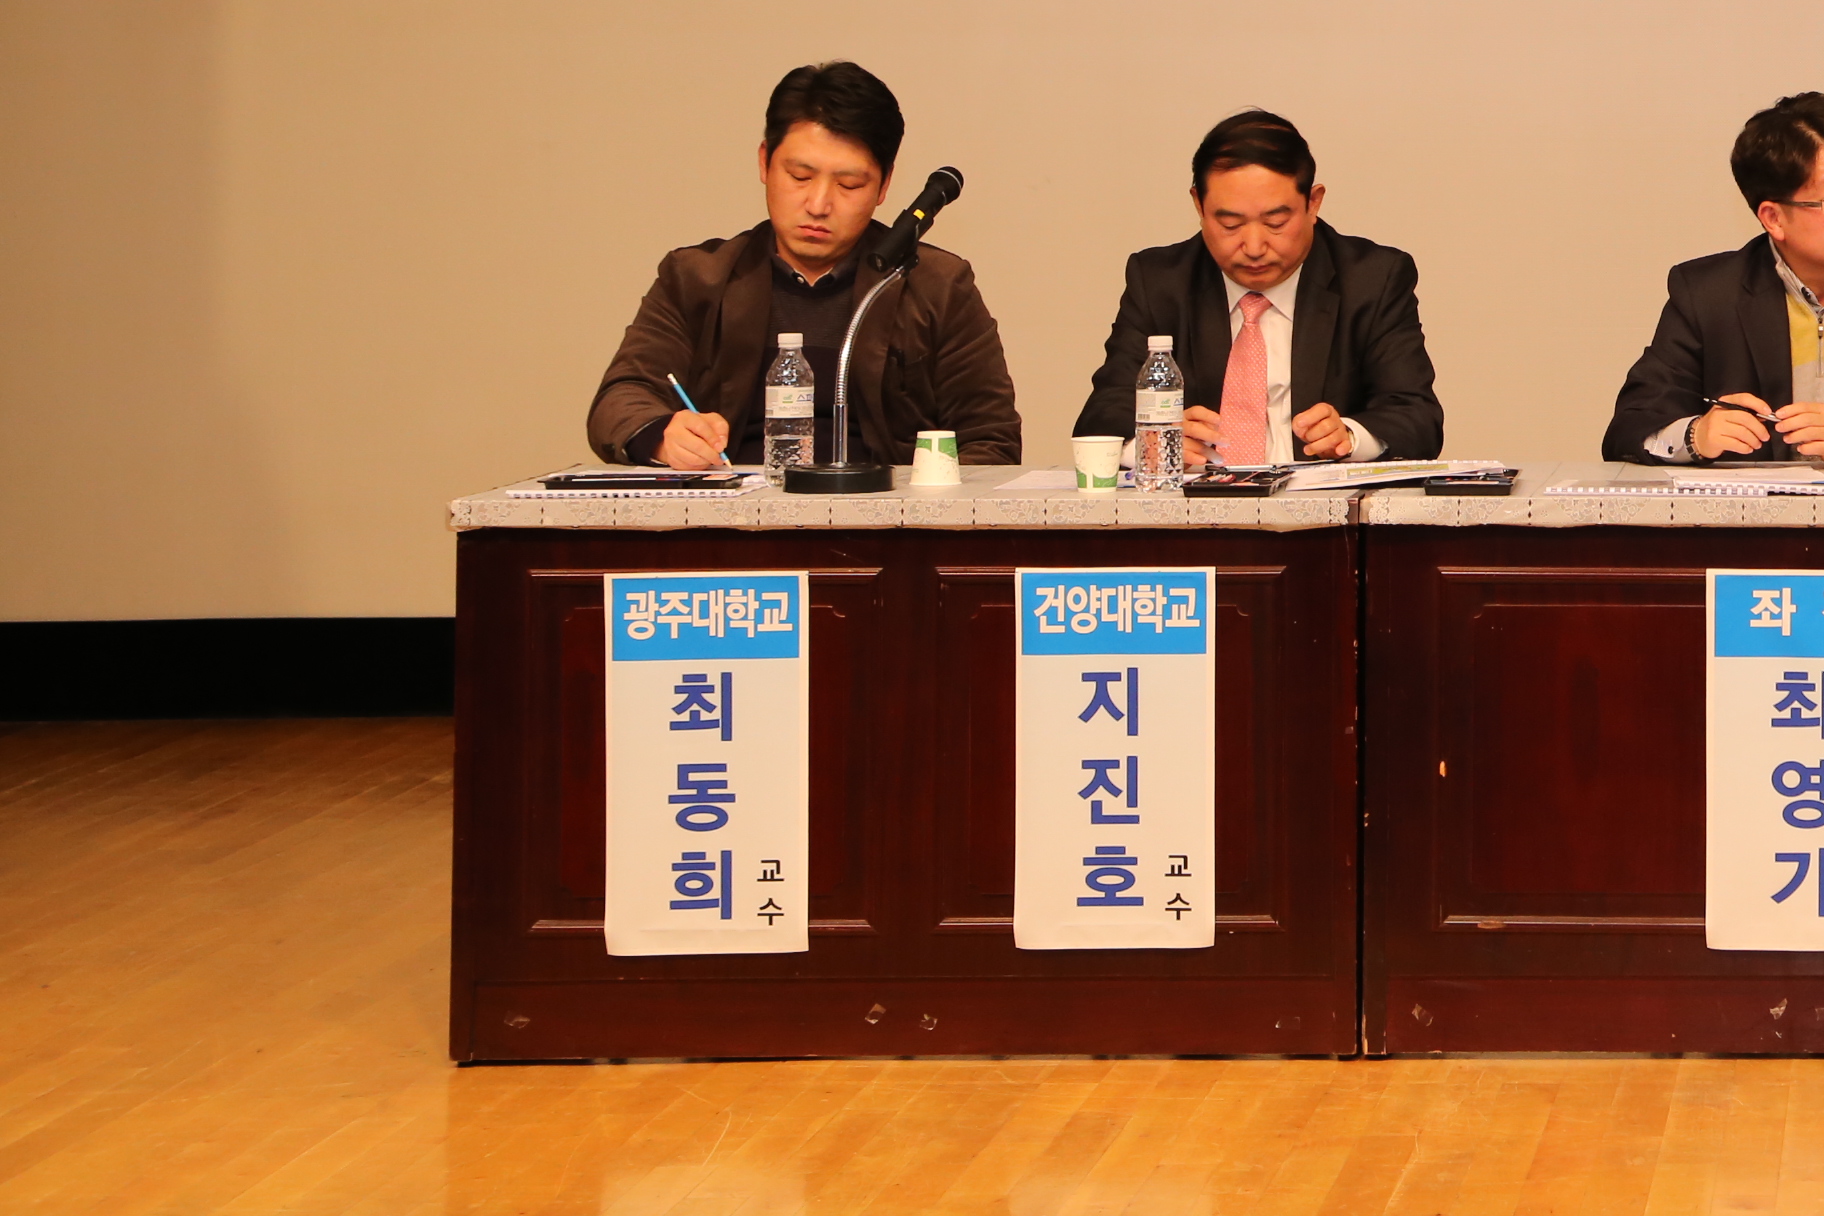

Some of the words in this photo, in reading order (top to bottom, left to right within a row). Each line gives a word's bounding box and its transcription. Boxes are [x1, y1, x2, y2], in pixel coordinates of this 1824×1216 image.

[624, 589, 793, 640] 광주대학교
[1034, 585, 1200, 633] 건양대학교
[669, 672, 735, 919] 최동희
[1077, 668, 1143, 906] 지진호
[758, 860, 783, 925] 교수
[1166, 856, 1191, 920] 교수
